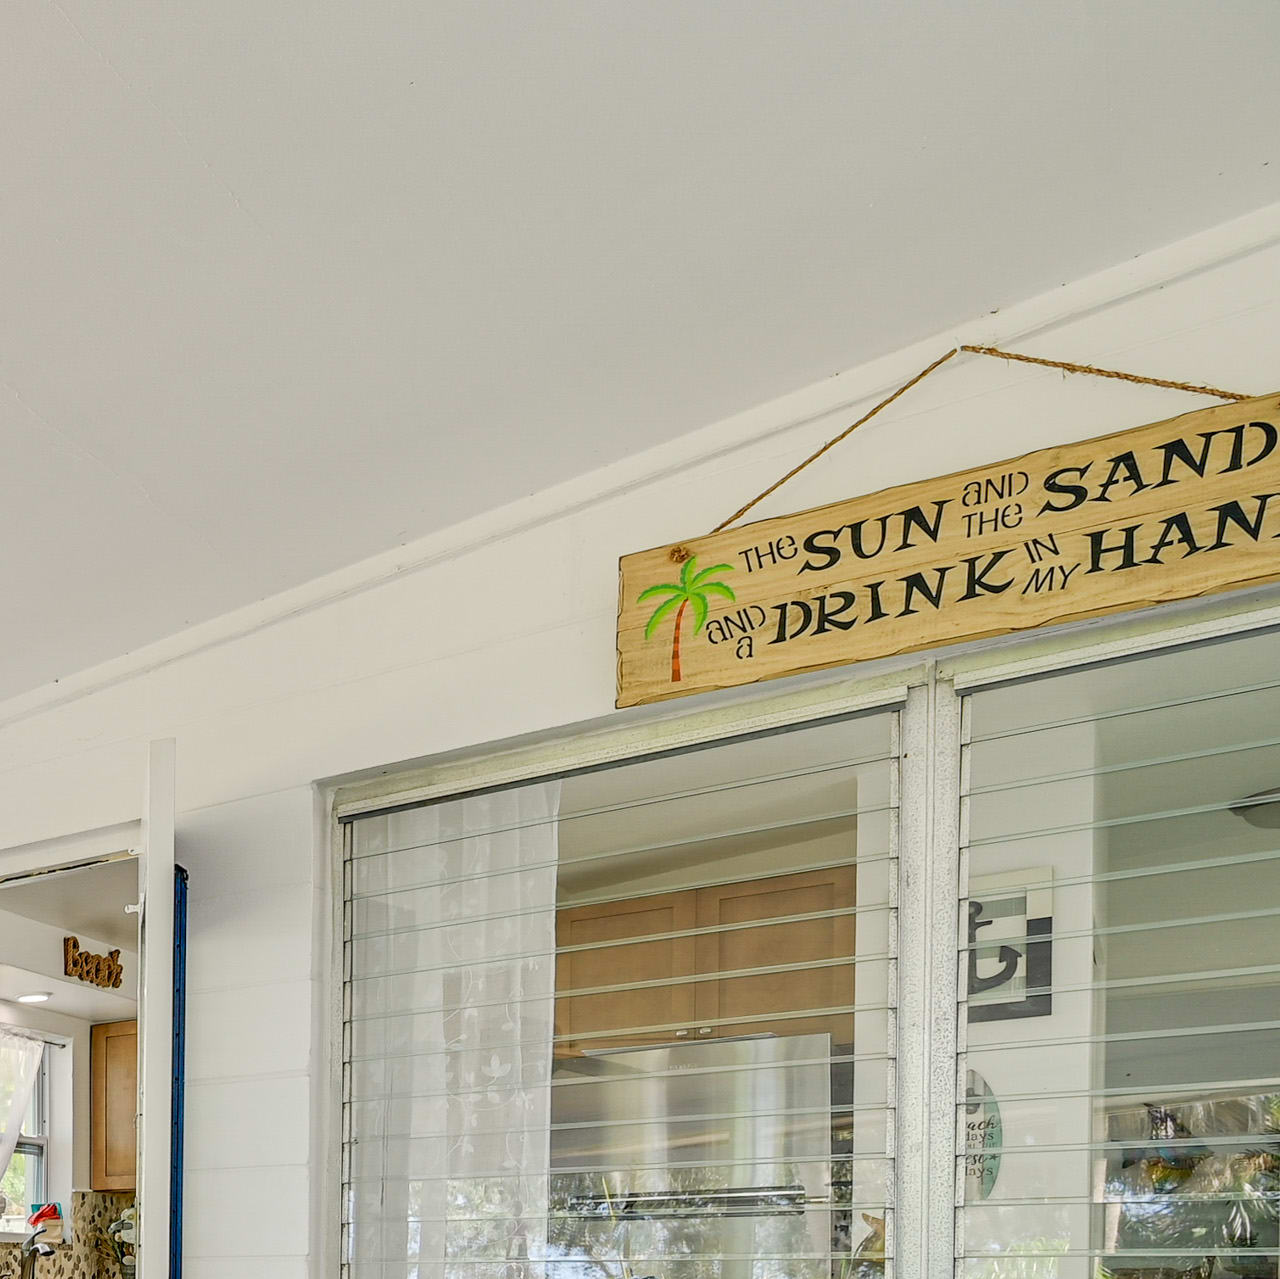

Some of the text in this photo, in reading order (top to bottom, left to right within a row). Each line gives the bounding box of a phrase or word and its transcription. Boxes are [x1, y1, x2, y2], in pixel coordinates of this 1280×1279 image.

[1036, 422, 1279, 517] SAND
[797, 499, 956, 576] SUN
[1022, 493, 1280, 595] MY HAN
[1023, 533, 1061, 564] IN
[767, 549, 1018, 645] DRINK
[967, 1115, 999, 1130] ach
